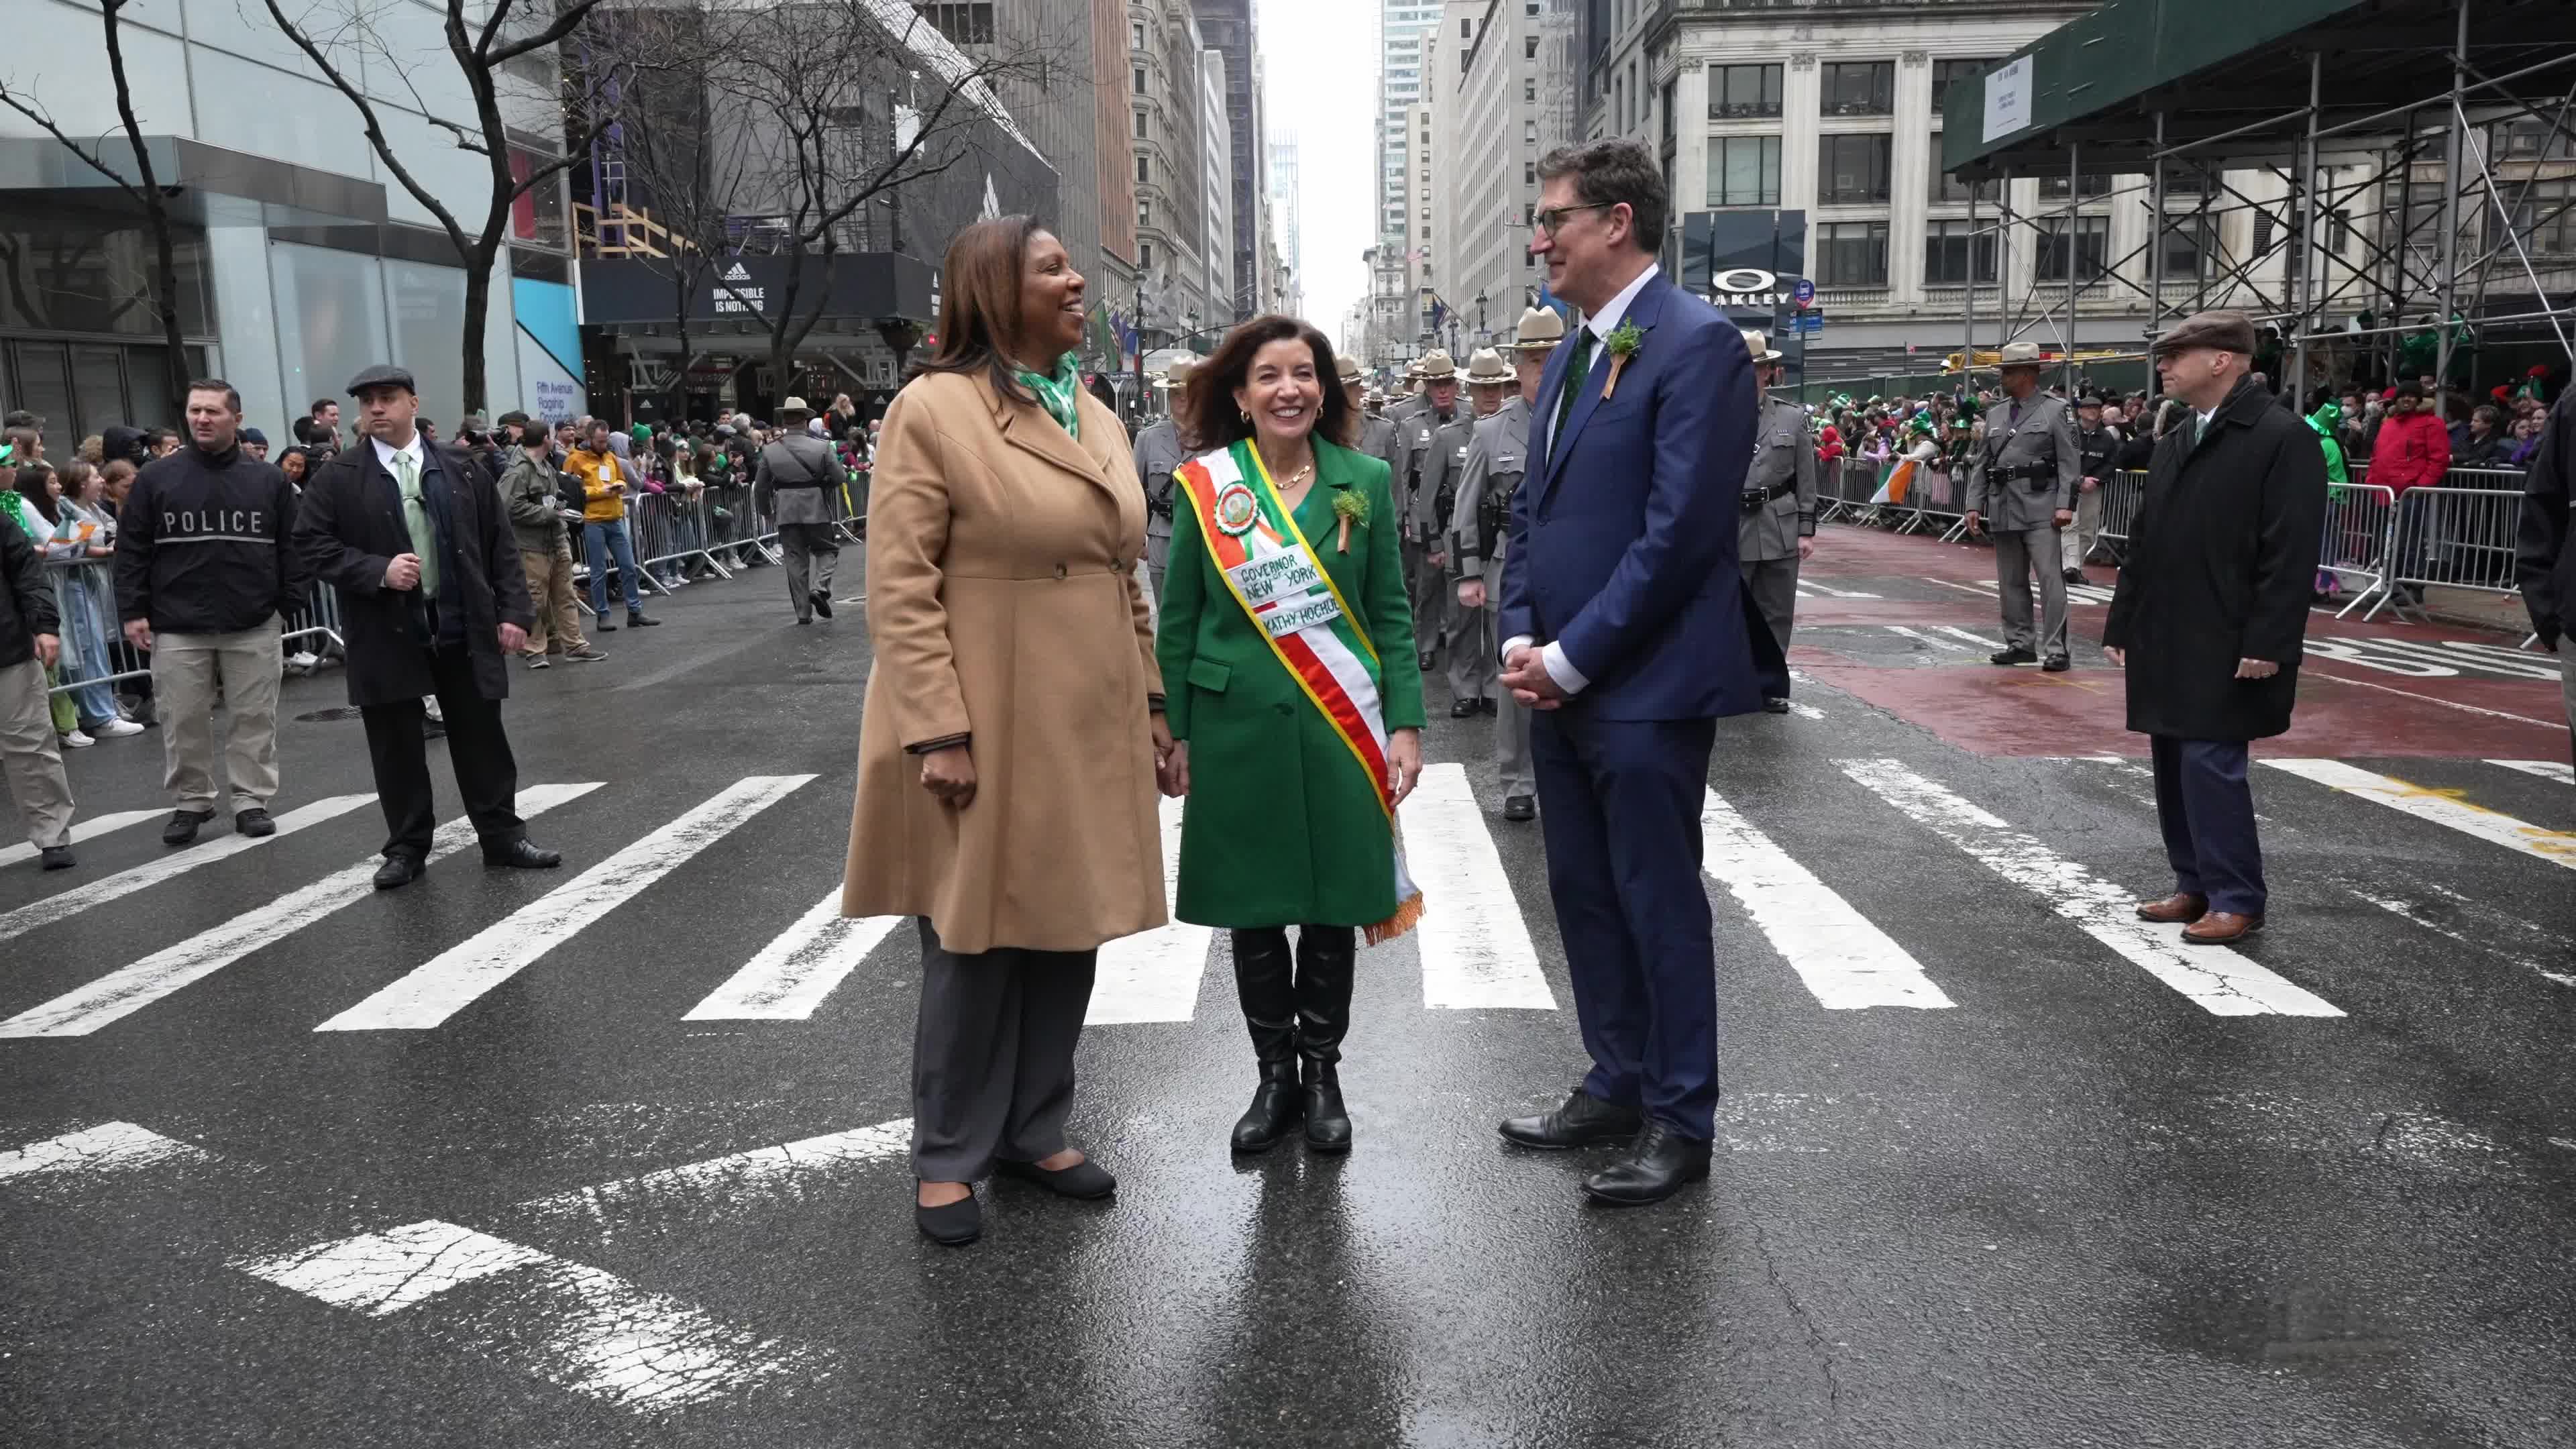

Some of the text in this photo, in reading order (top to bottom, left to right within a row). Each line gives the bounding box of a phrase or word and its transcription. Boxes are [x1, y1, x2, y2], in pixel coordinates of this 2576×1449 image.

[715, 300, 763, 312] IS NOTNG
[164, 510, 262, 533] POLICE
[1241, 554, 1297, 582] GOVERNOR
[1246, 565, 1317, 600] NEW YORK
[1263, 596, 1340, 634] KATHY HOCHUL
